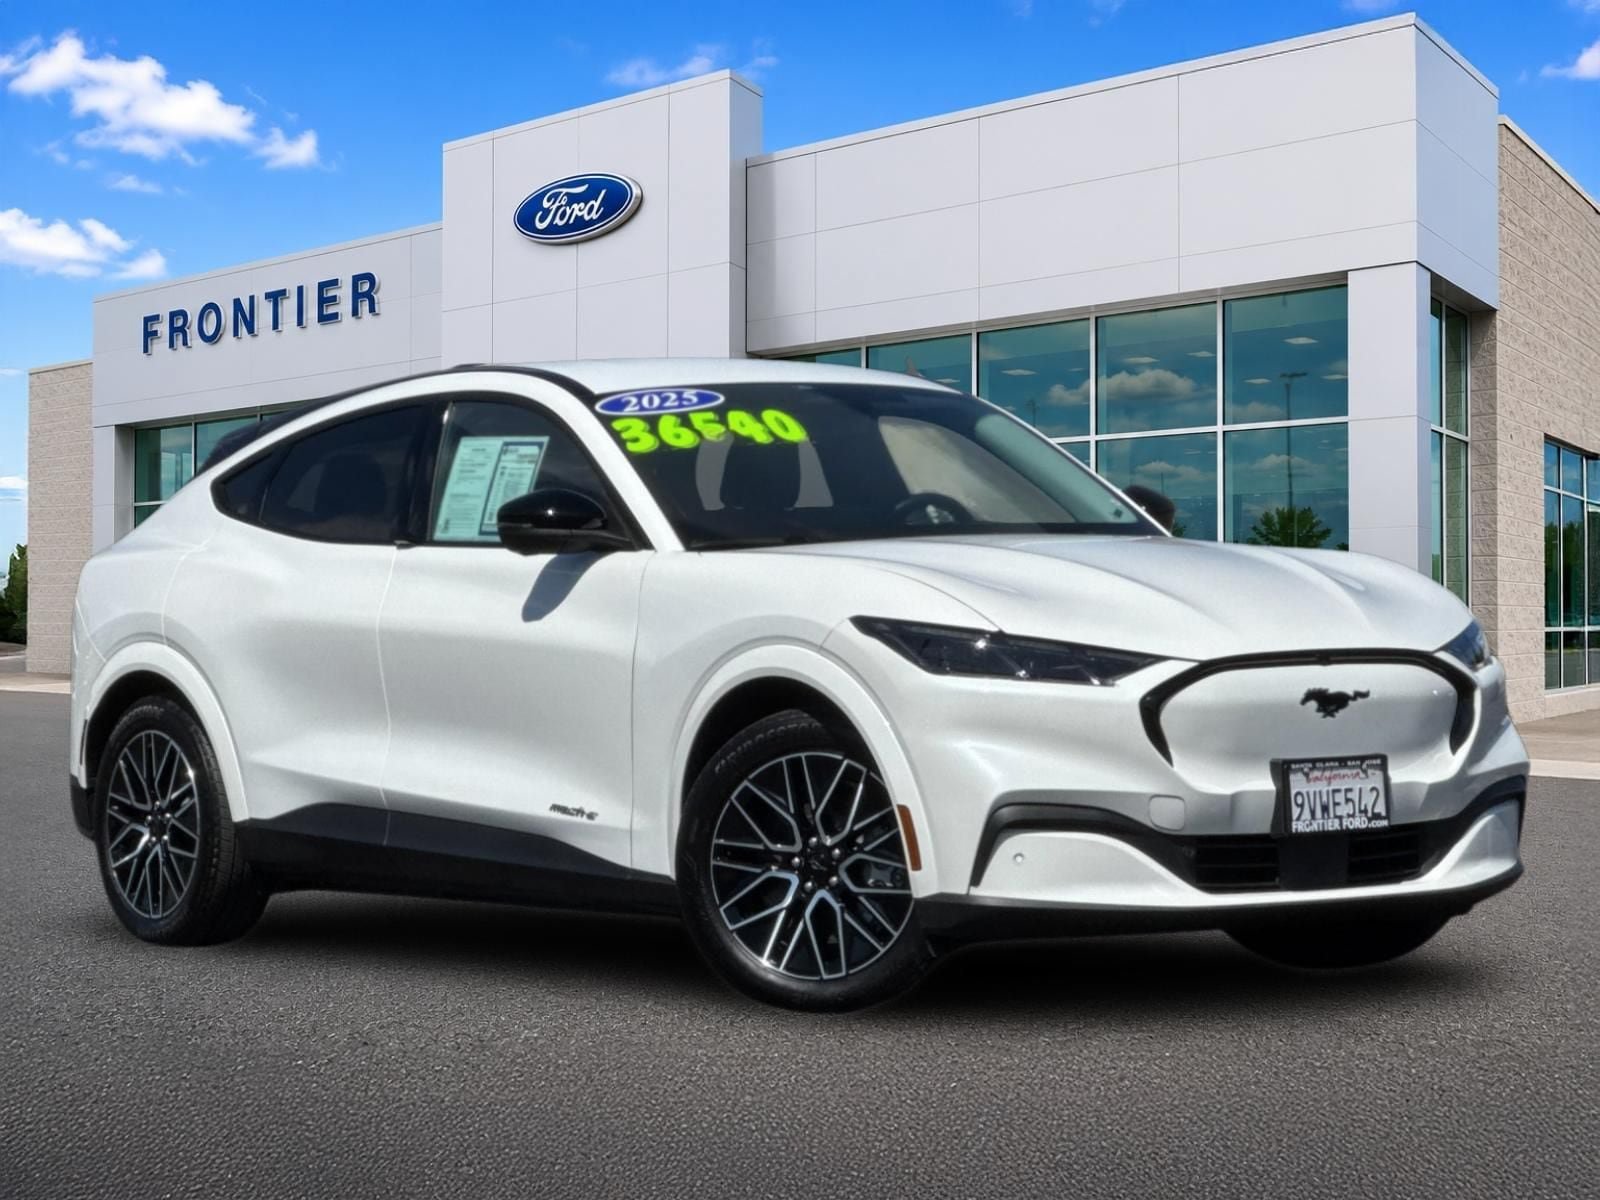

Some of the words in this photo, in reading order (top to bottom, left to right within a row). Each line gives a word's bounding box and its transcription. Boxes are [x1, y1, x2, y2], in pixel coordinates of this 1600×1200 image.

[535, 184, 606, 229] Ford
[142, 271, 380, 355] FRONTIER
[621, 390, 699, 412] 2025
[611, 409, 808, 453] 36540
[1293, 787, 1382, 820] 9VWE542
[1292, 819, 1341, 833] FRONTIER
